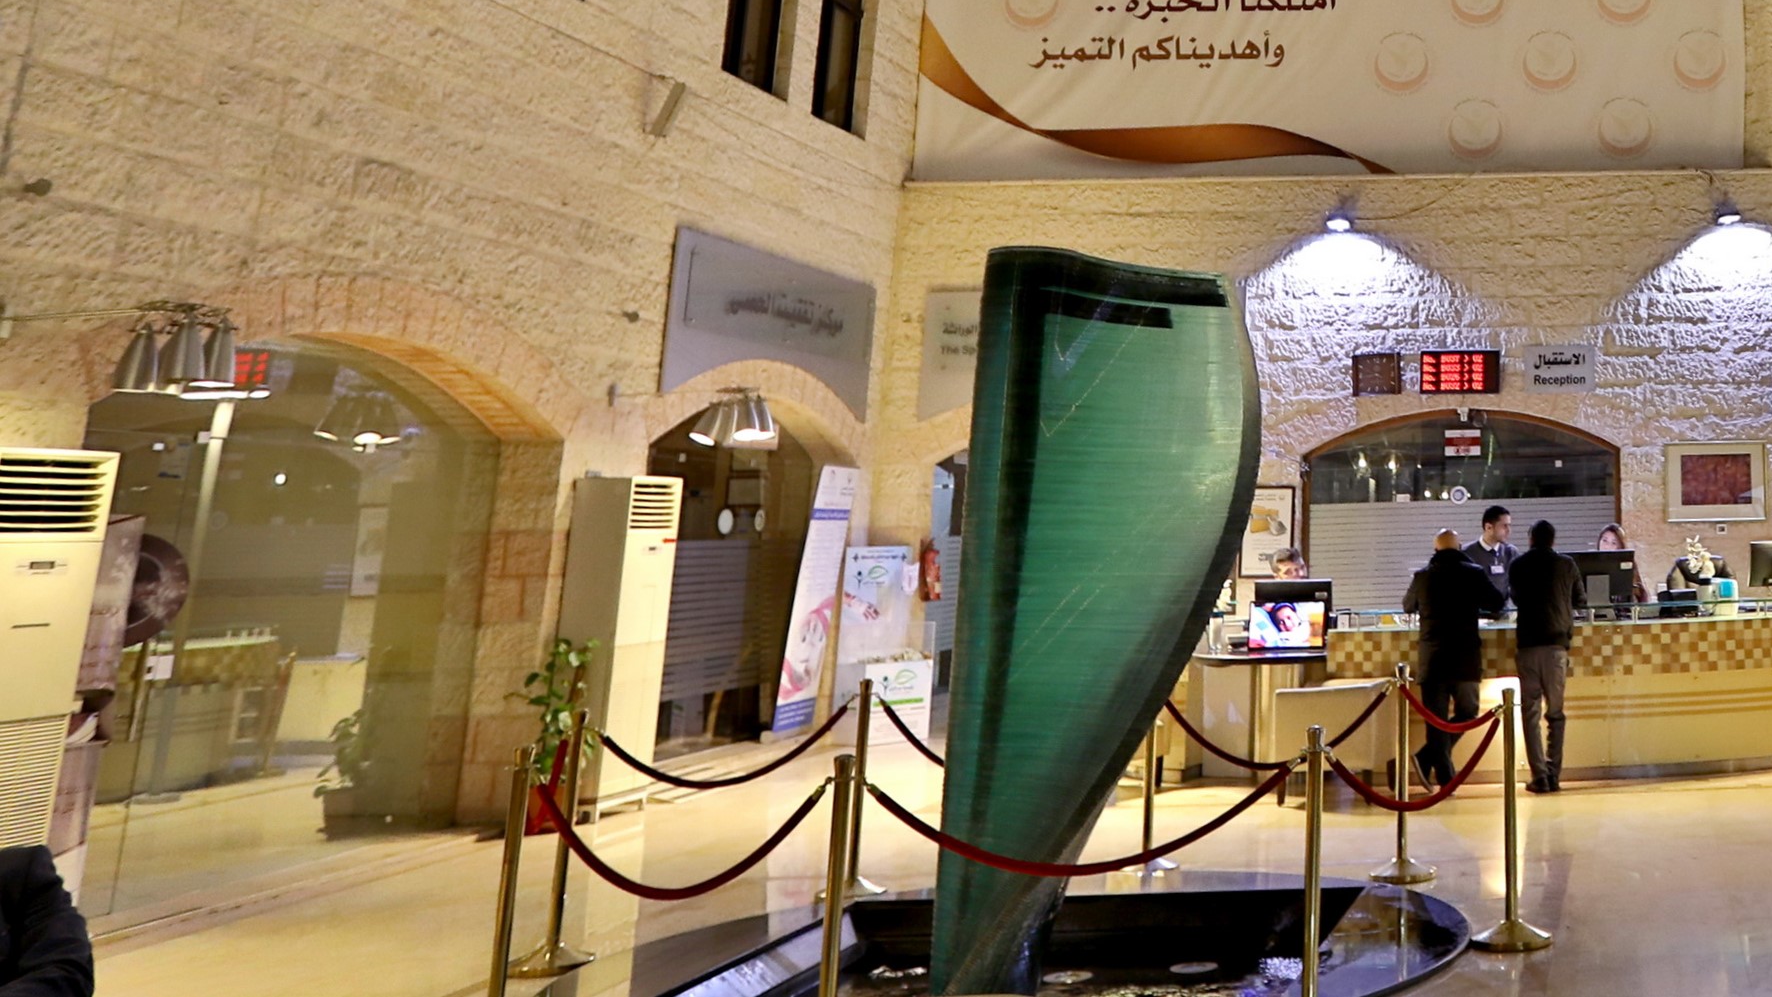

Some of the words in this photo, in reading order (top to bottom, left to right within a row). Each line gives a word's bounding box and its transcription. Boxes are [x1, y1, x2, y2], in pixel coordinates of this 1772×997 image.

[1028, 35, 1125, 70] التميز
[1131, 30, 1285, 71] وأهديناكم
[1534, 352, 1586, 370] الاستقبال
[1534, 374, 1586, 386] Reception
